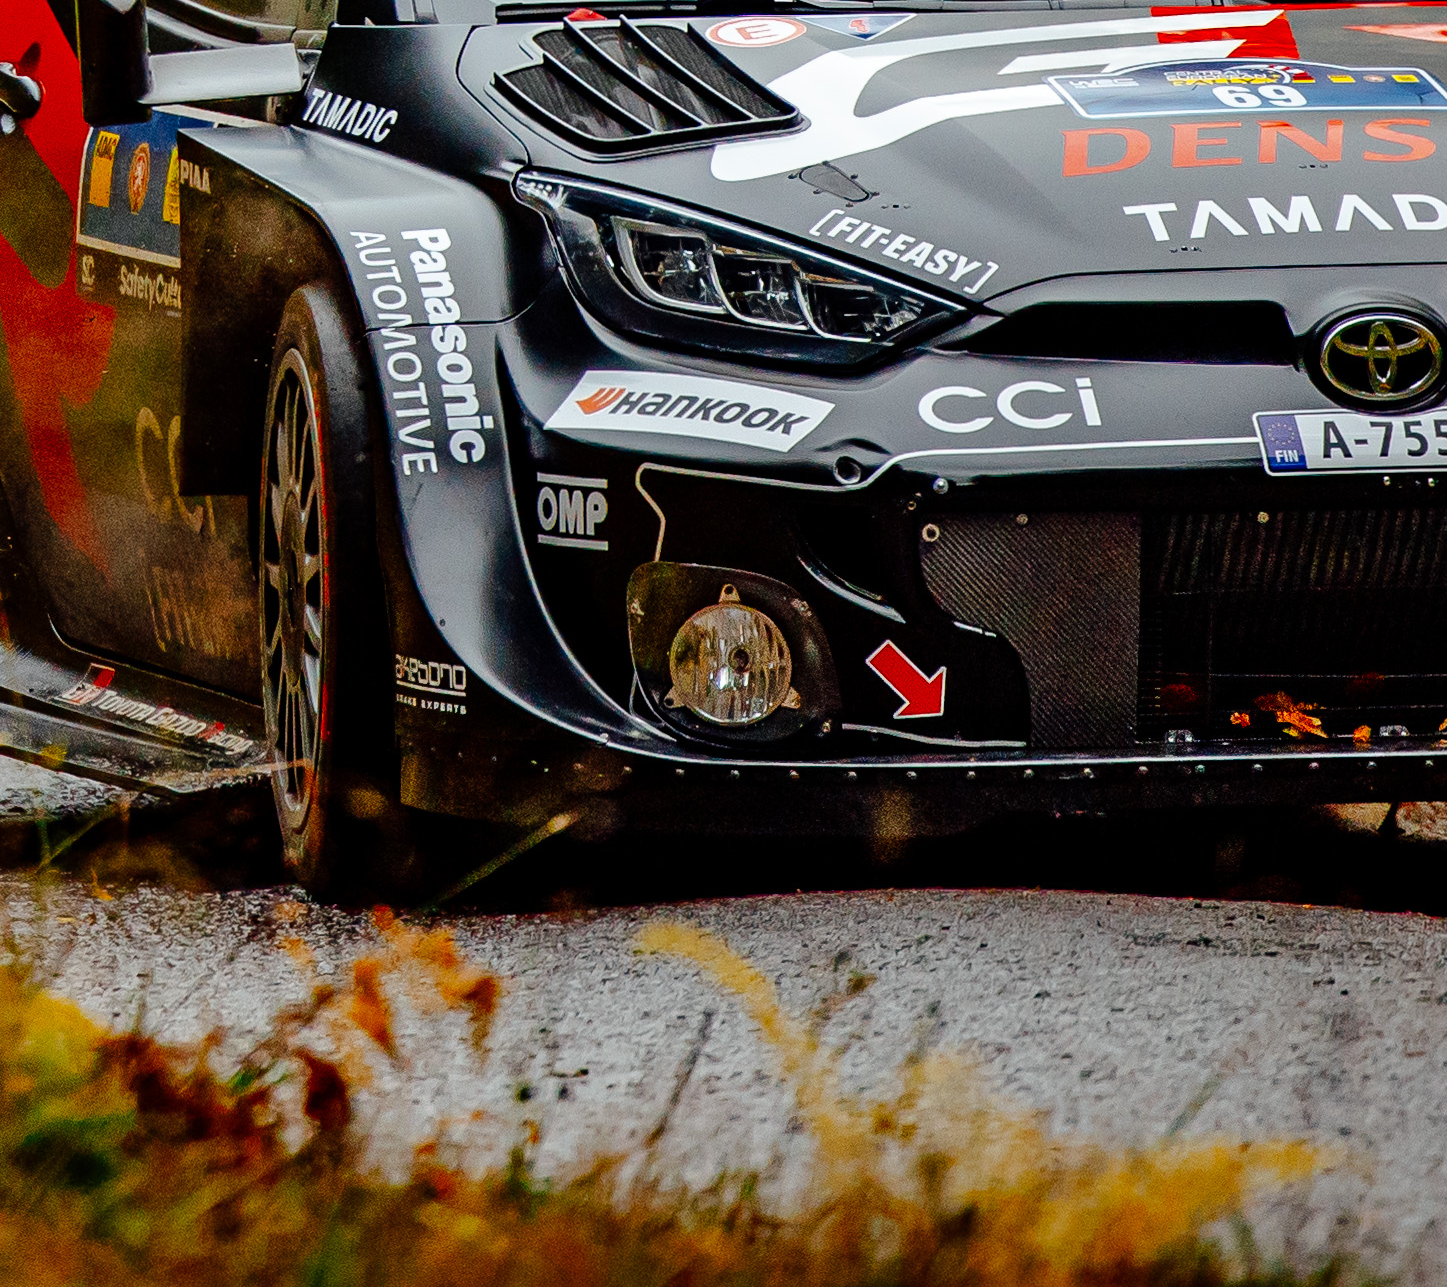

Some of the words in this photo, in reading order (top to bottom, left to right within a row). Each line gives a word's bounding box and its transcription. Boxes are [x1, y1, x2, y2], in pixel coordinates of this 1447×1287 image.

[1212, 84, 1308, 108] 69
[302, 87, 399, 143] TAMADIC
[180, 157, 212, 194] PIAA
[349, 230, 439, 477] AUTOMOTIVE
[400, 227, 495, 464] Panasonic
[1274, 448, 1300, 464] FIN
[537, 485, 609, 536] OMP
[91, 689, 158, 722] TOYOTA
[420, 699, 467, 715] EXPERTS
